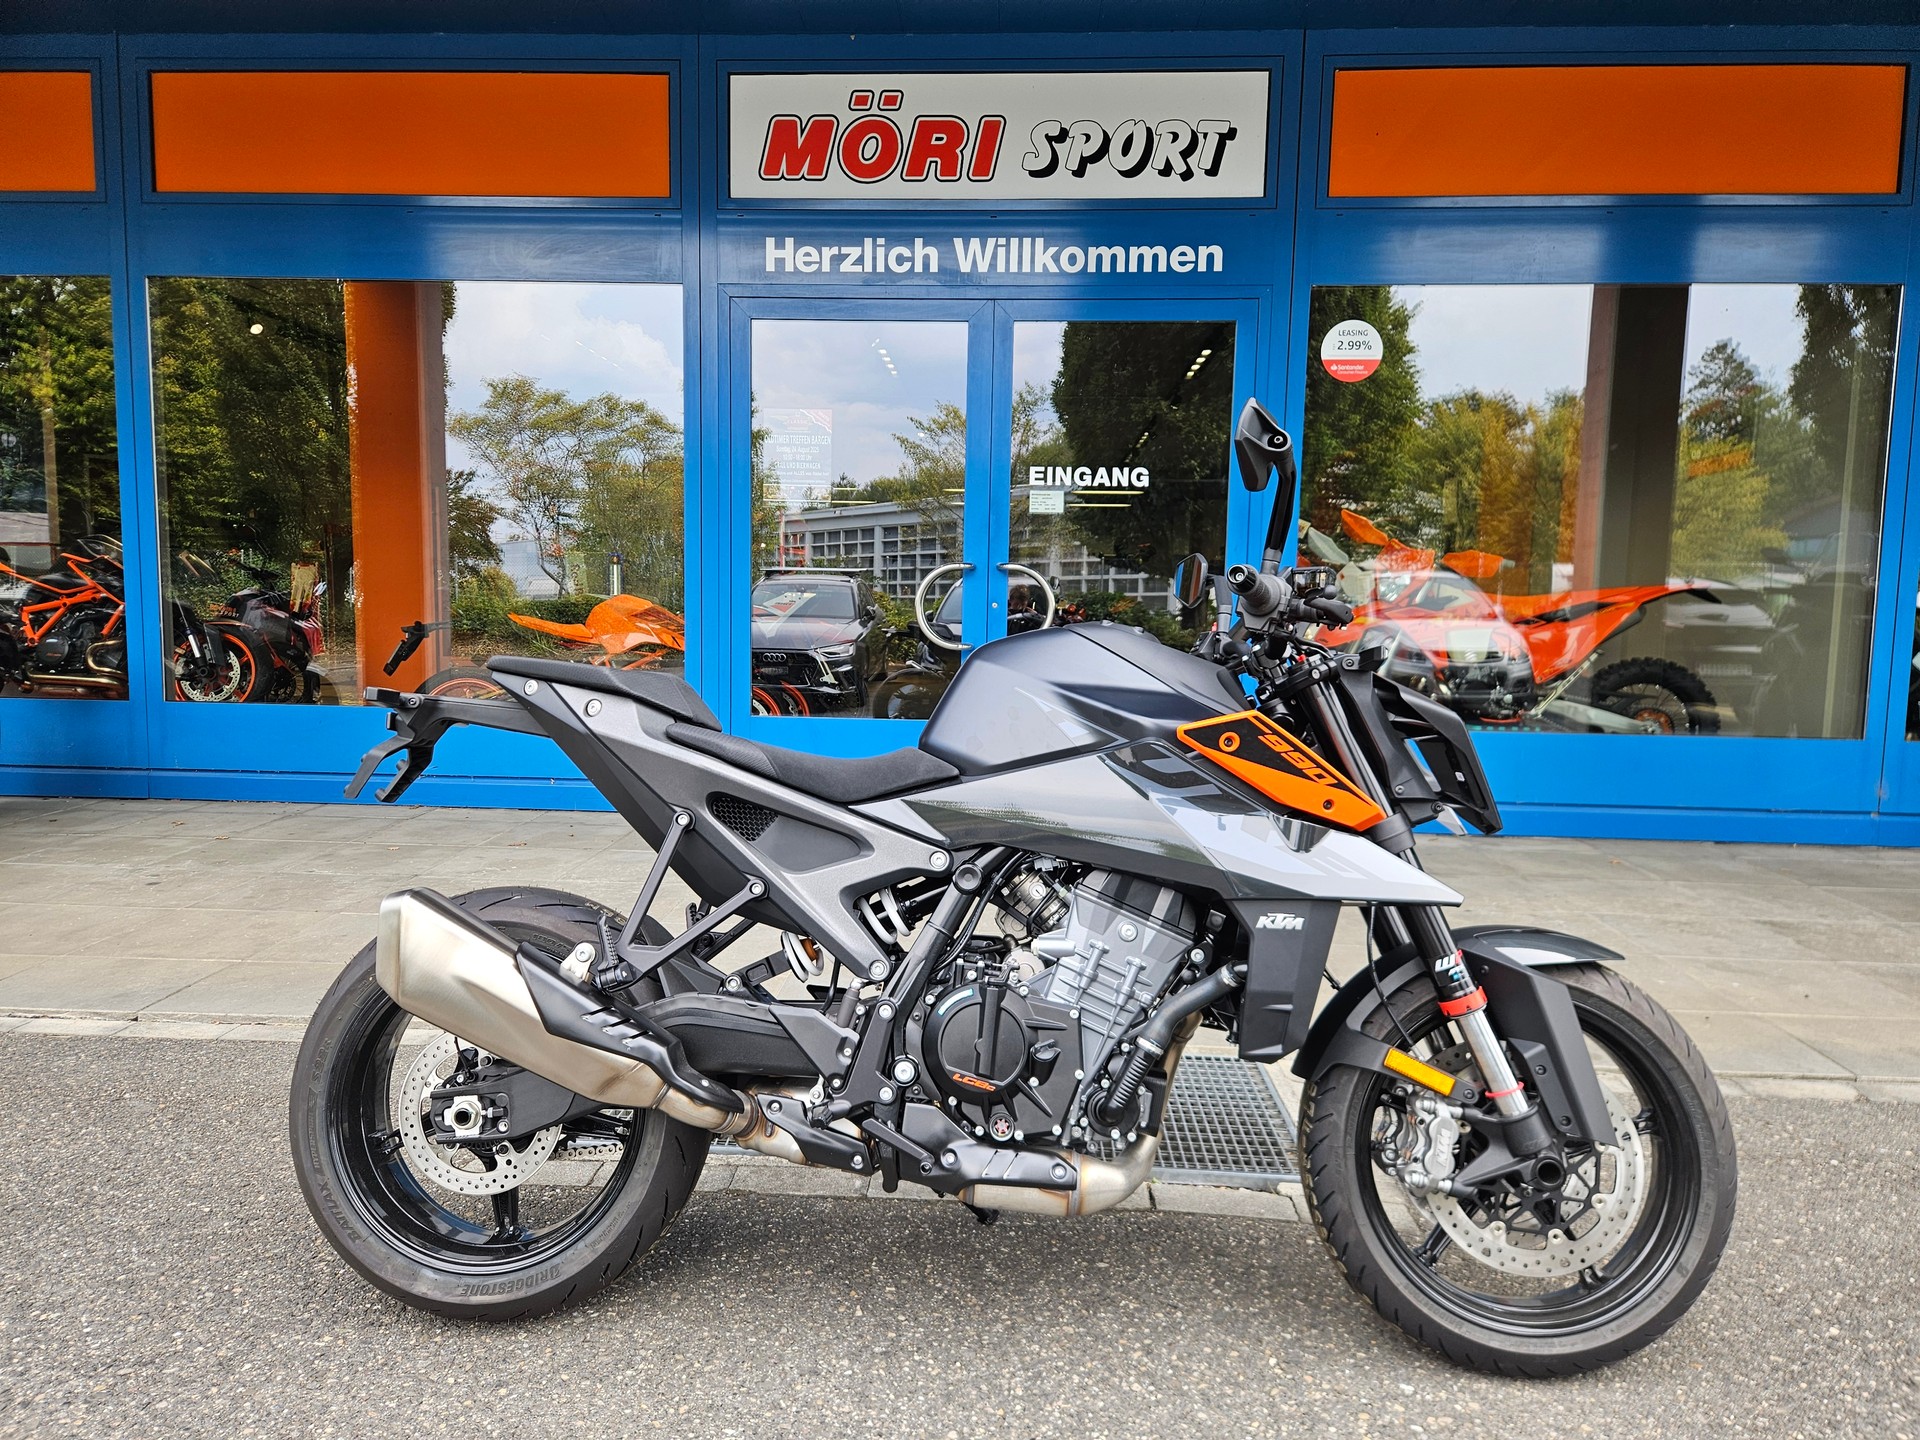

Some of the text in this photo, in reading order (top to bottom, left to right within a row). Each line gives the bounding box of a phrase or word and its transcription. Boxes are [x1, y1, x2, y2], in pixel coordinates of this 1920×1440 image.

[759, 90, 1237, 184] MÖRI SPORT
[765, 237, 1223, 273] Herzlich Willkommen
[1337, 340, 1372, 350] 2.99%
[791, 435, 811, 445] TREFFEN
[1029, 466, 1149, 488] EINGANG
[1258, 735, 1339, 785] 990
[1255, 912, 1305, 931] KTM
[318, 1177, 362, 1243] BATTLAX
[460, 1262, 561, 1297] BRIDGESTONE
